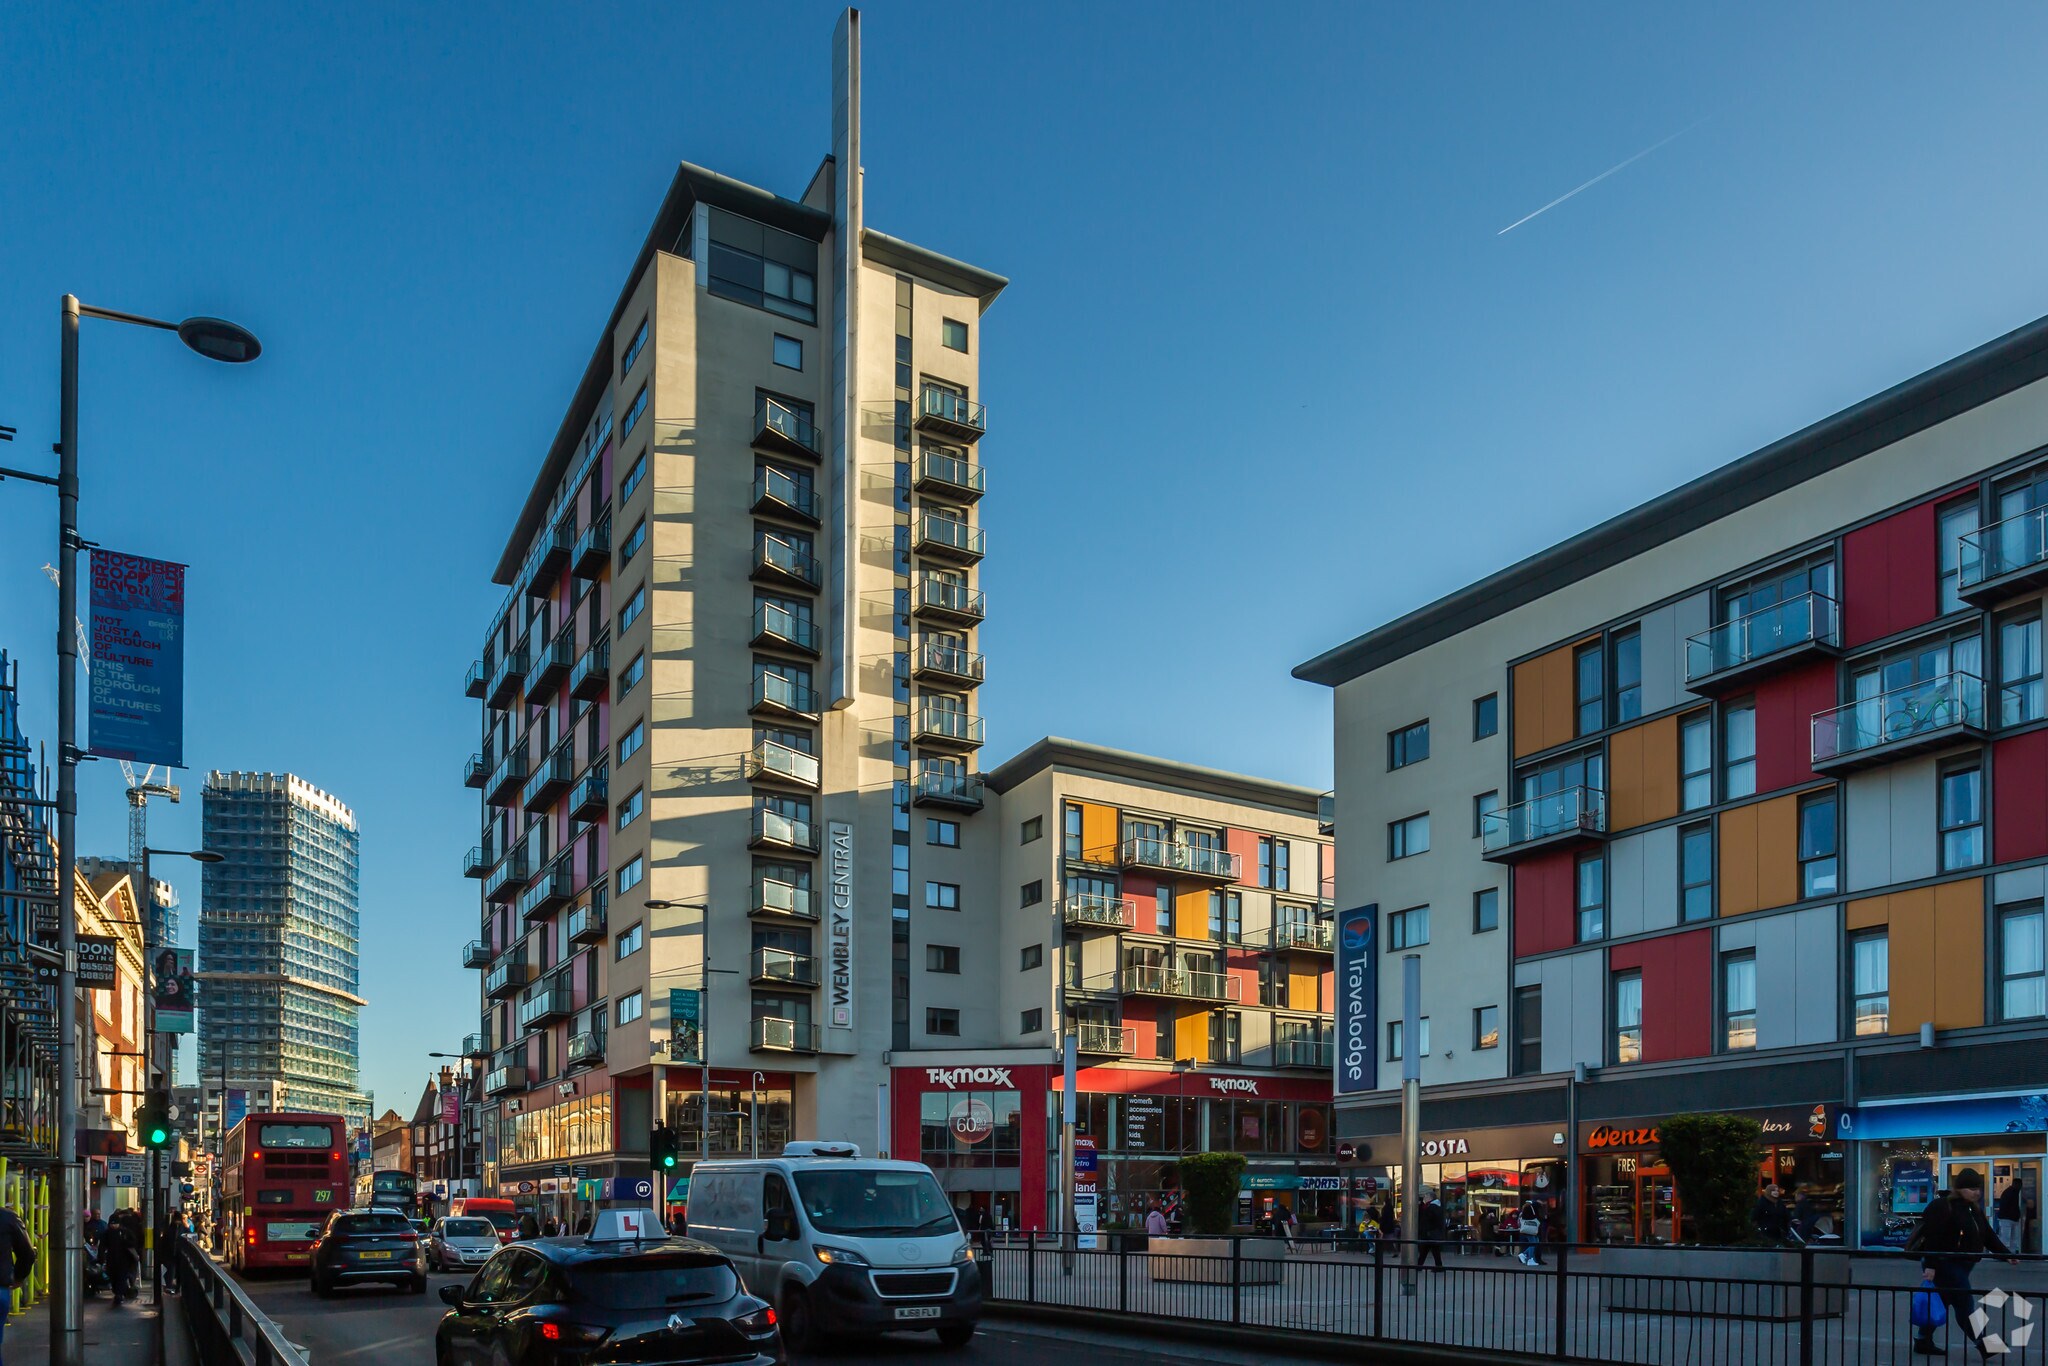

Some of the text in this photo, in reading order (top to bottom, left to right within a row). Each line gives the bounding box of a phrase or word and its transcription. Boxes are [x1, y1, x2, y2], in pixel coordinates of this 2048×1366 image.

[94, 614, 122, 627] NOT
[94, 624, 142, 639] JUST A
[94, 632, 161, 651] BOROUGH
[94, 641, 112, 651] OF
[94, 651, 154, 668] CULTURE
[94, 660, 124, 671] THIS
[94, 668, 135, 682] IS THE
[94, 678, 161, 695] BOROUGH
[94, 686, 112, 697] OF
[94, 695, 162, 713] CULTURES
[833, 825, 850, 1006] WEMBLEY CENTRAL
[1345, 951, 1368, 1081] Travelodge
[1762, 1118, 1792, 1133] kers
[1128, 1131, 1141, 1139] kids
[1075, 1139, 1095, 1149] maxx
[1128, 1139, 1146, 1147] home
[1617, 1158, 1636, 1173] FRES
[638, 1185, 649, 1193] BT
[1075, 1182, 1096, 1193] land
[1302, 1177, 1339, 1189] SPORTS
[315, 1190, 332, 1202] 297
[624, 1216, 639, 1231] L
